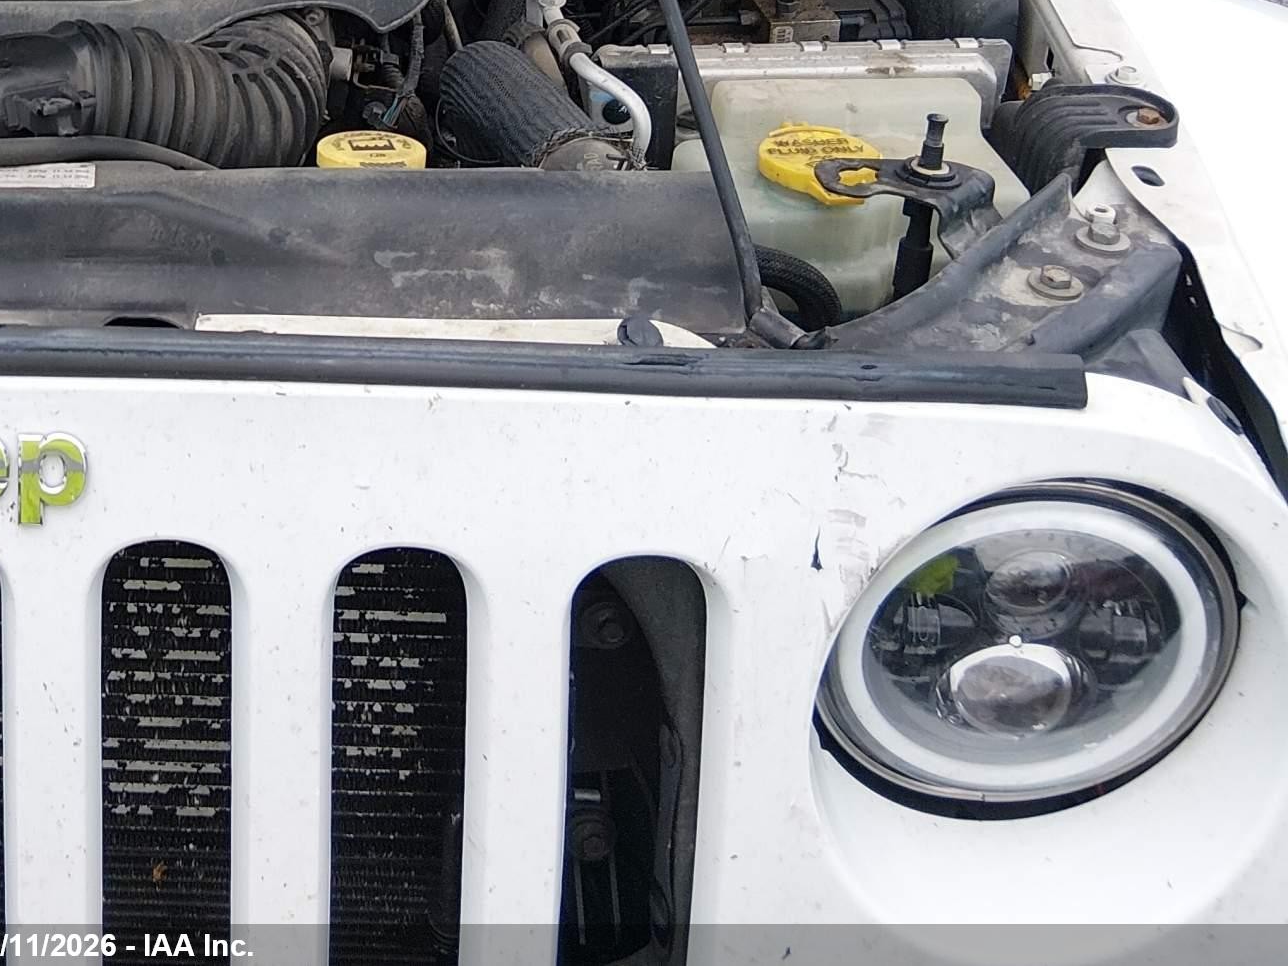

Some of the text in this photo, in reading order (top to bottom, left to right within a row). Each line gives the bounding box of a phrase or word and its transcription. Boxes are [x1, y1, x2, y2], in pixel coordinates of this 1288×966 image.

[774, 137, 849, 147] WASHER
[767, 145, 864, 155] FLUID ONLY
